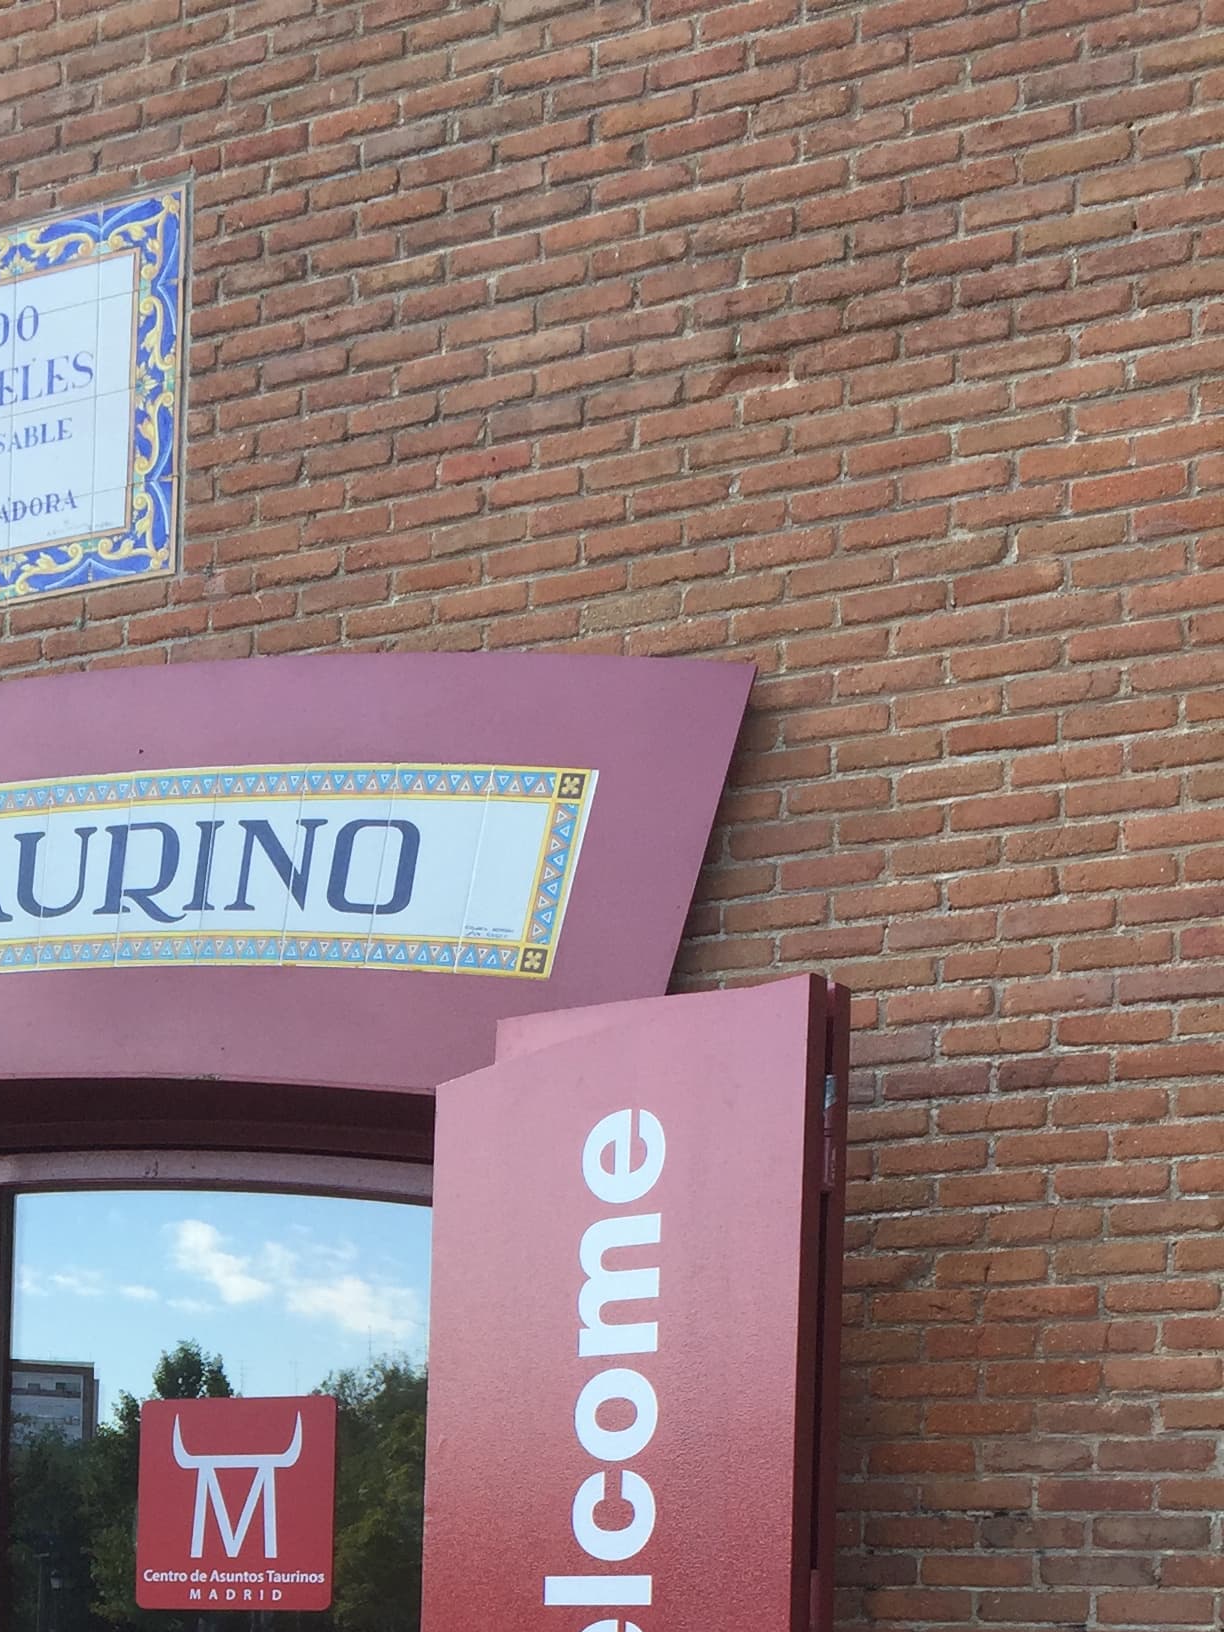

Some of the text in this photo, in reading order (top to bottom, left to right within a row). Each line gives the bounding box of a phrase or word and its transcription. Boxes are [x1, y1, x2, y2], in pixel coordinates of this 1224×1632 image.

[143, 1569, 325, 1583] Centro de Asuntos Taurinos
[189, 1589, 282, 1600] MADRID
